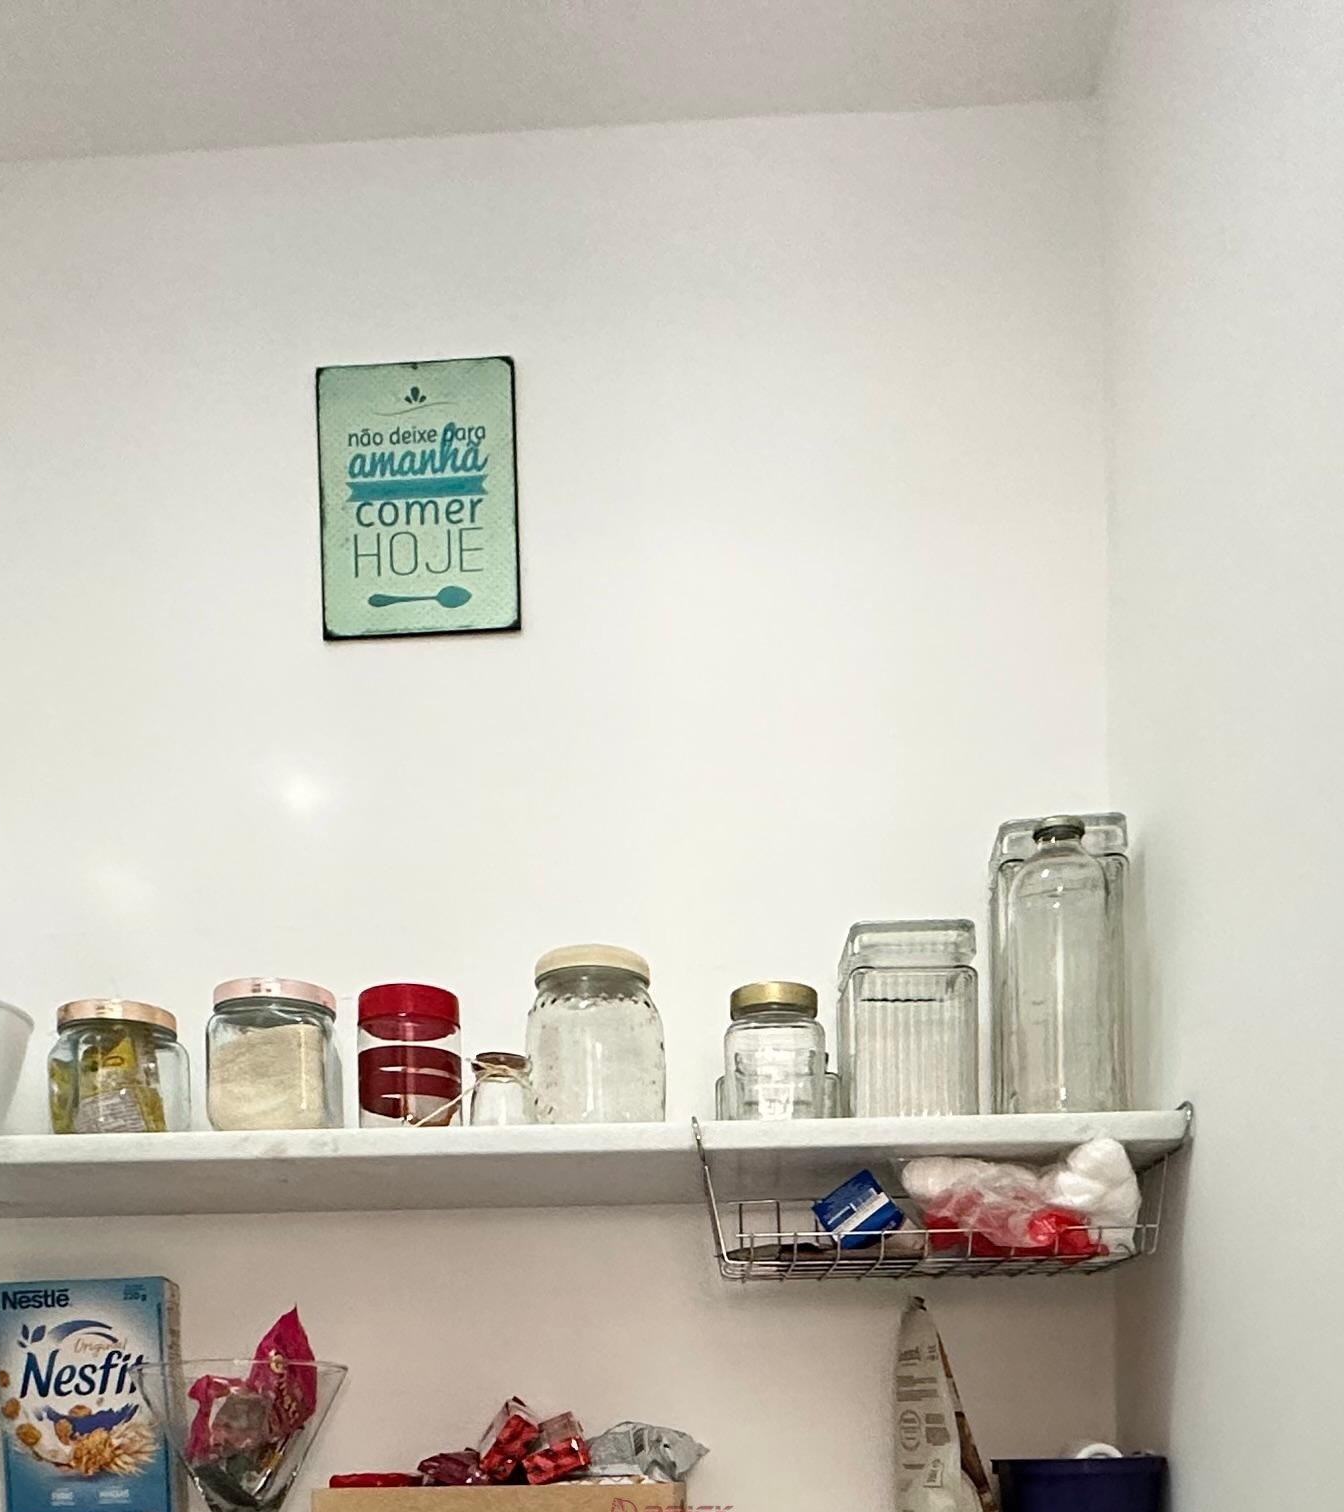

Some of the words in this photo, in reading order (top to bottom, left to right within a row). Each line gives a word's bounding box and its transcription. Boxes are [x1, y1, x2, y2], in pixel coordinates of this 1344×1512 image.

[347, 428, 383, 447] não
[389, 426, 438, 446] deixe
[441, 424, 486, 446] para
[347, 422, 490, 479] amanhã
[356, 498, 484, 527] comer
[353, 527, 484, 578] HOJE
[1, 1288, 70, 1310] Nestlé
[19, 1348, 147, 1398] Nesfit
